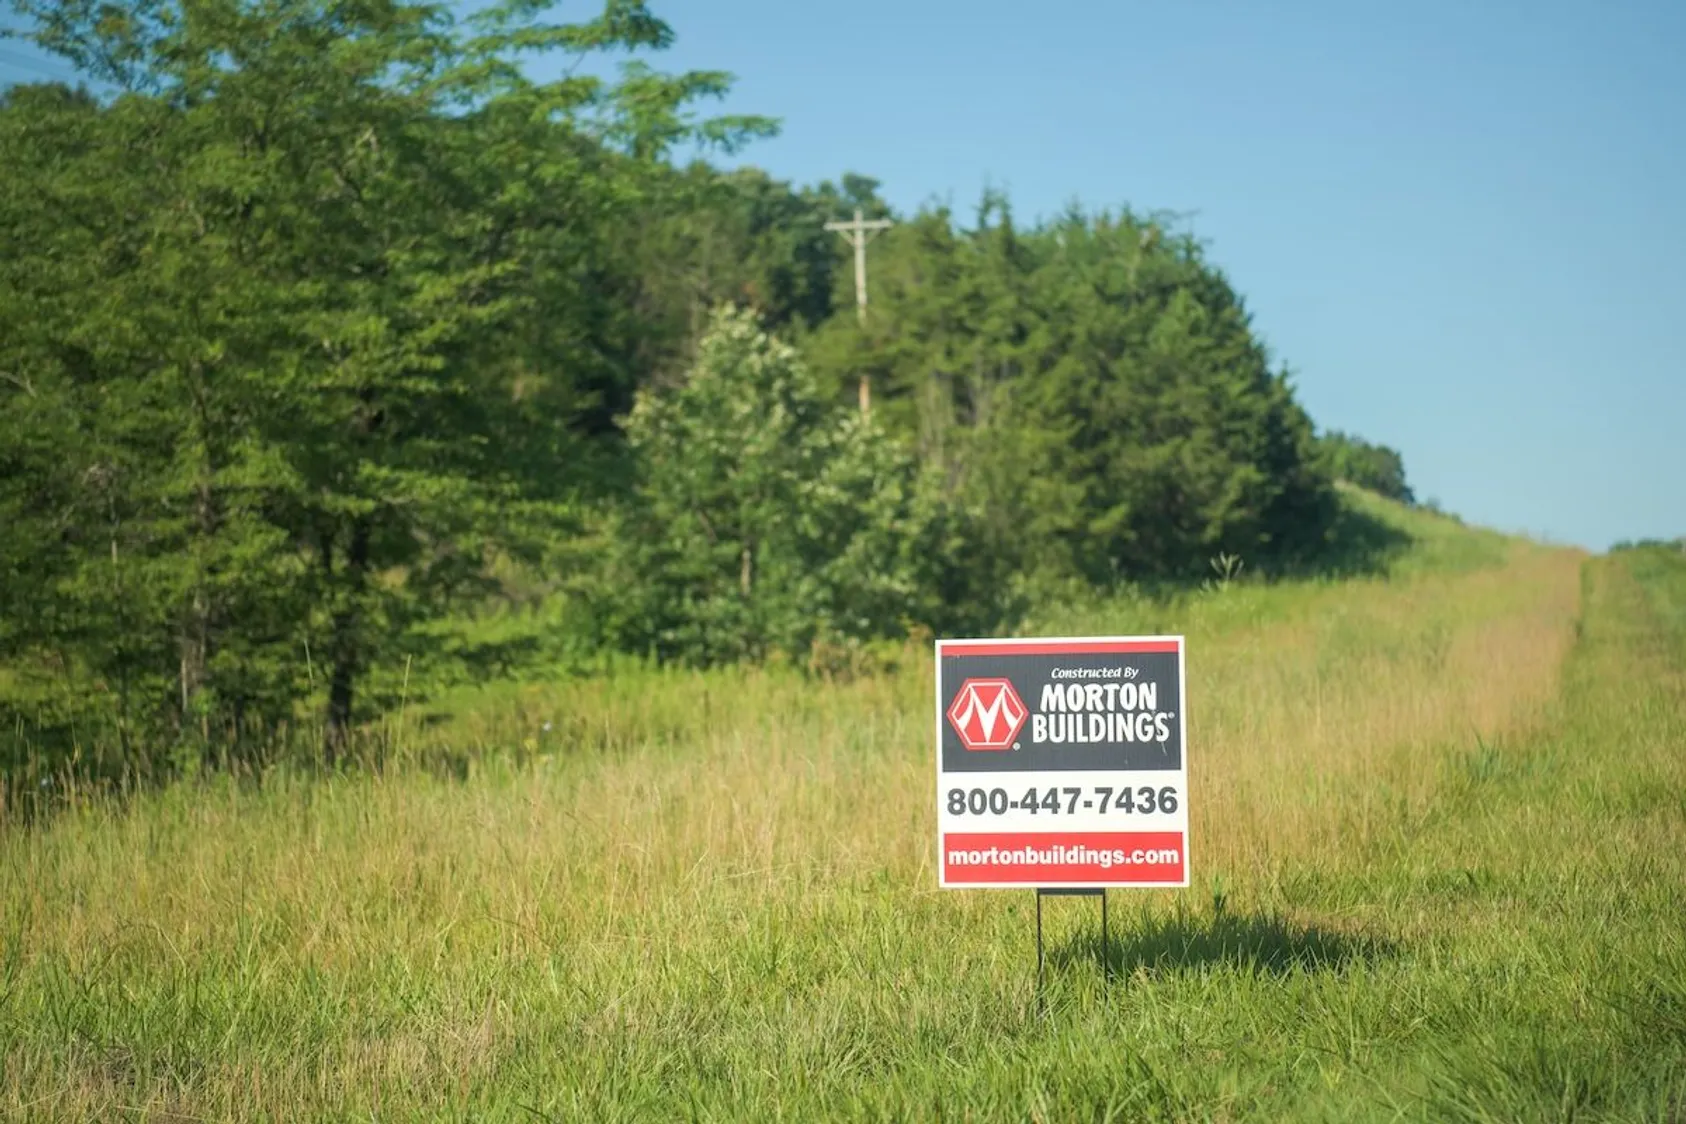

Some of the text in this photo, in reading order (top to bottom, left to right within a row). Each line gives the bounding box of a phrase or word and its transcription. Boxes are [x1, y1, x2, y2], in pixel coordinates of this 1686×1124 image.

[1051, 667, 1139, 679] Constructed By
[1040, 682, 1157, 713] MORTON
[947, 786, 1178, 816] 800-447-7436
[948, 845, 1179, 868] mortonbuildings.com
